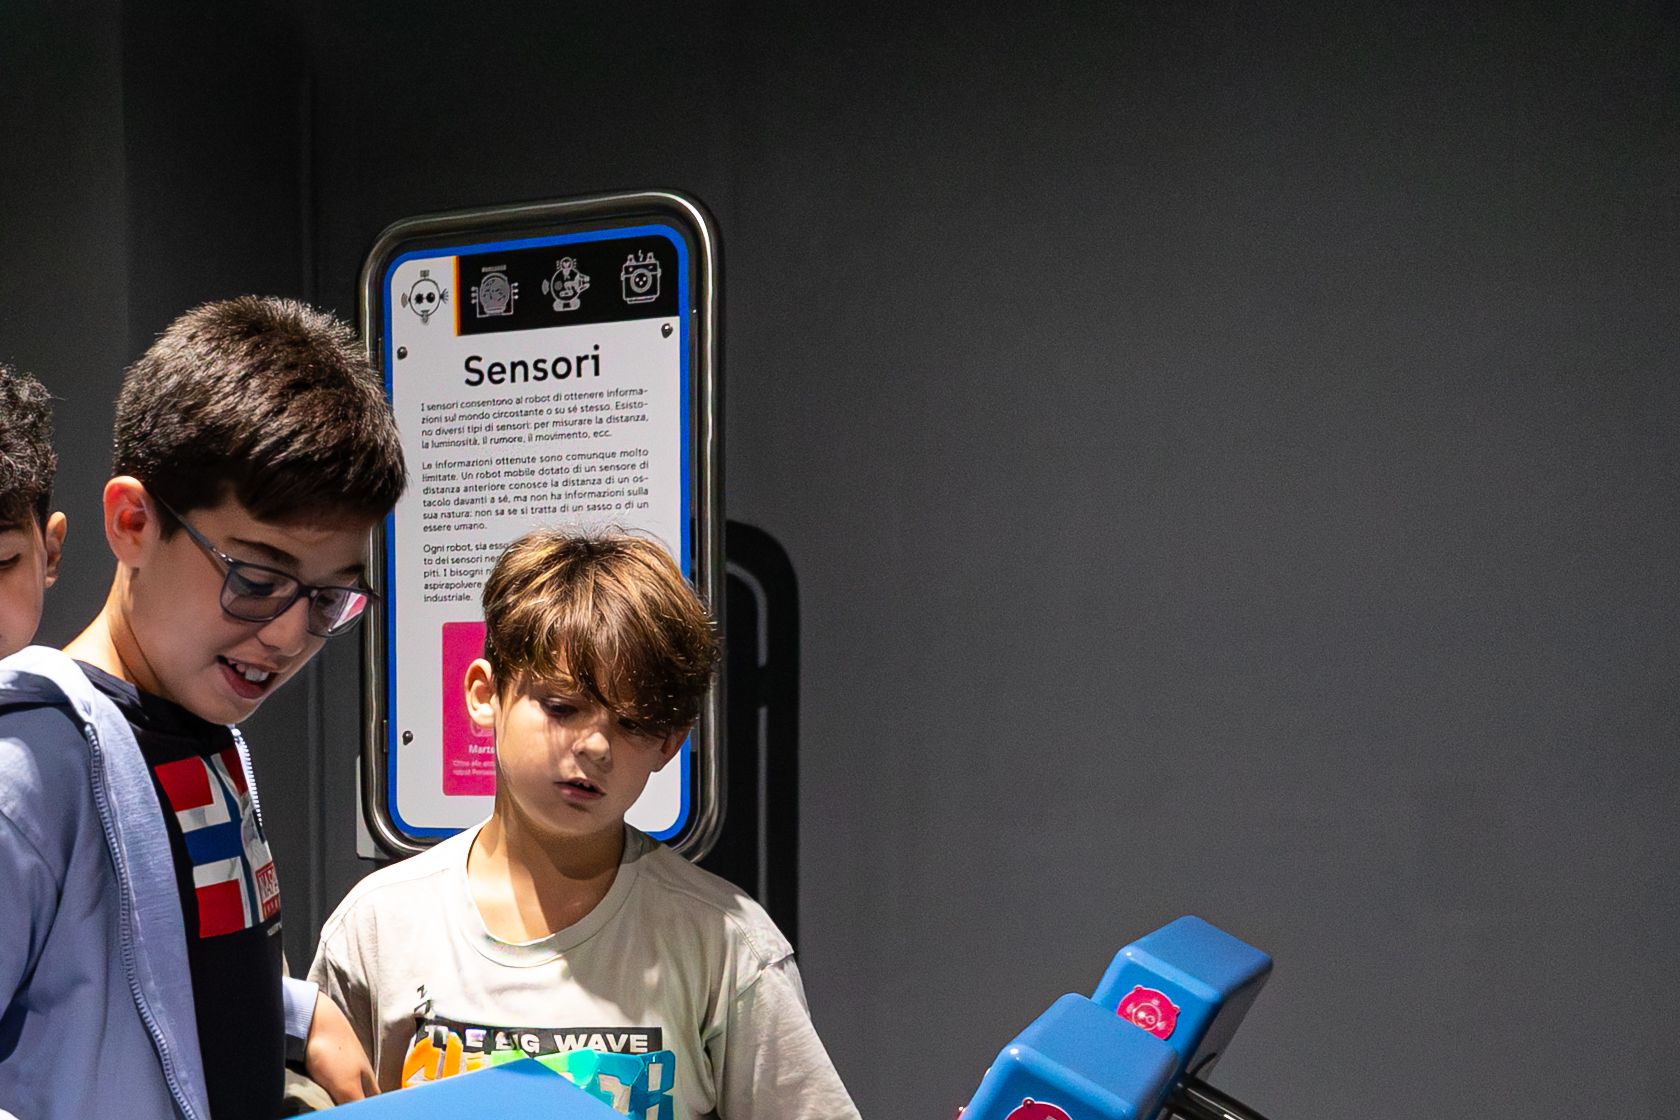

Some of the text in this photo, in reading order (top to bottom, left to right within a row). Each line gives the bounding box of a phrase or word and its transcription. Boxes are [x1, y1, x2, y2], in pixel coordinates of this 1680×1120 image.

[464, 344, 600, 387] Sensori
[420, 388, 647, 412] I sensori consentono al robot di ottenere informa-
[421, 413, 442, 424] zioni
[444, 412, 456, 423] sul
[458, 411, 490, 422] mondo
[491, 408, 544, 419] circostante
[545, 408, 552, 416] o
[614, 401, 648, 411] Esisto-
[421, 429, 433, 437] no
[434, 424, 464, 436] diversi
[466, 423, 482, 435] tipi
[484, 422, 494, 432] di
[533, 421, 549, 431] per
[552, 418, 592, 428] misurare
[594, 415, 603, 425] la
[421, 440, 429, 449] la
[482, 435, 488, 445] il
[527, 432, 533, 442] il
[422, 448, 648, 470] Le informazioni ottenute sono comunque molto
[460, 470, 474, 480] Un
[475, 469, 501, 479] robot
[503, 466, 535, 477] mobile
[537, 466, 570, 475] dotato
[572, 463, 582, 473] di
[584, 465, 596, 473] un
[598, 463, 636, 472] sensore
[638, 459, 648, 469] di
[422, 485, 460, 495] distanza
[462, 482, 506, 493] anteriore
[508, 481, 548, 490] conosce
[550, 478, 559, 488] la
[561, 477, 602, 487] distanza
[604, 475, 614, 485] di
[632, 475, 648, 483] os-
[422, 496, 451, 507] tacolo
[453, 494, 487, 505] davanti
[489, 496, 495, 504] a
[529, 494, 548, 502] non
[550, 491, 562, 500] ha
[564, 487, 624, 500] informazioni
[626, 486, 648, 497] sulla
[474, 509, 492, 517] non
[494, 508, 504, 516] sa
[520, 505, 528, 514] si
[530, 504, 557, 514] tratta
[559, 503, 569, 512] di
[571, 504, 584, 512] un
[586, 503, 612, 511] sasso
[614, 502, 622, 510] o
[624, 499, 634, 509] di
[636, 501, 649, 509] un
[422, 523, 452, 532] essere
[423, 544, 444, 554] Ogni
[475, 541, 487, 550] sia
[424, 557, 432, 565] to
[435, 556, 449, 565] dei
[451, 555, 482, 564] sensori
[443, 568, 447, 577] I
[450, 568, 483, 578] bisogni
[424, 581, 481, 591] aspirapolvere
[554, 1033, 648, 1052] WAVE
